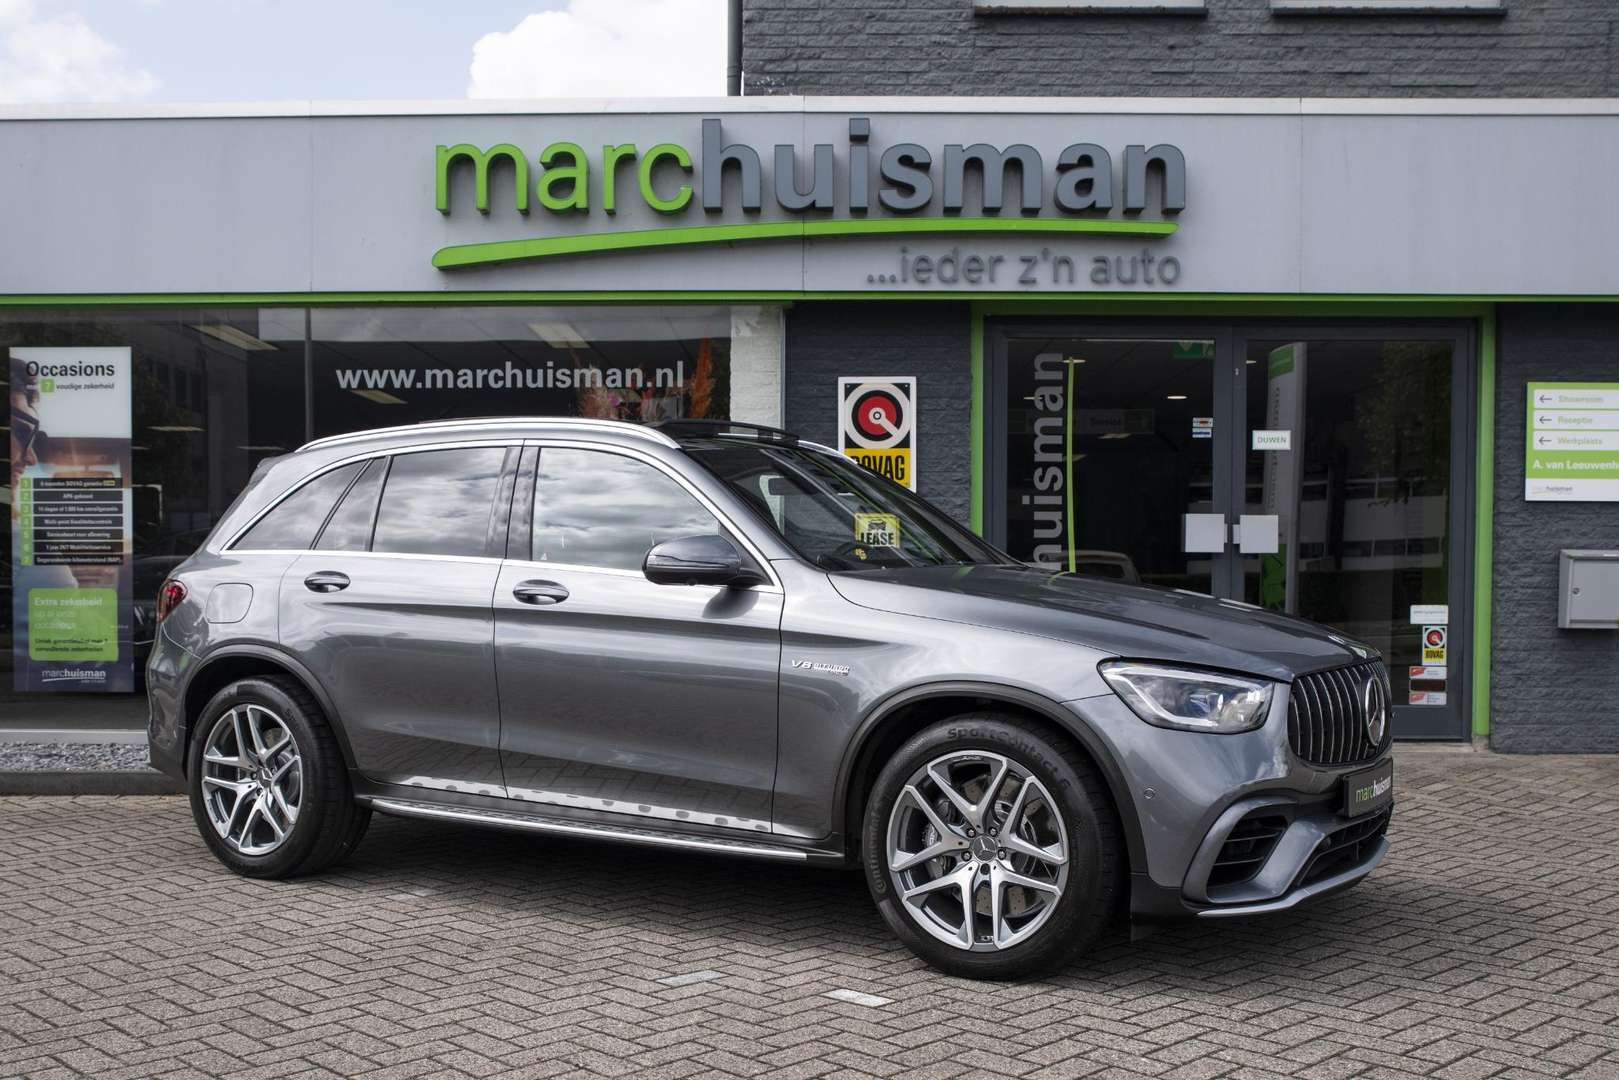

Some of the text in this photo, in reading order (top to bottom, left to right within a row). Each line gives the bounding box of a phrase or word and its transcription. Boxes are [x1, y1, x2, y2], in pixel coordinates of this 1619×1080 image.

[435, 117, 1186, 215] marchuisman
[866, 247, 1182, 284] ...ieder z'n auto
[26, 360, 115, 377] Occasions
[335, 360, 684, 389] www.marchuisman.nl
[56, 382, 82, 391] voudige
[1257, 436, 1287, 444] DUWEN
[1546, 462, 1564, 470] van
[860, 532, 894, 545] LEASE
[791, 659, 812, 669] V8
[41, 668, 106, 678] marchuisman
